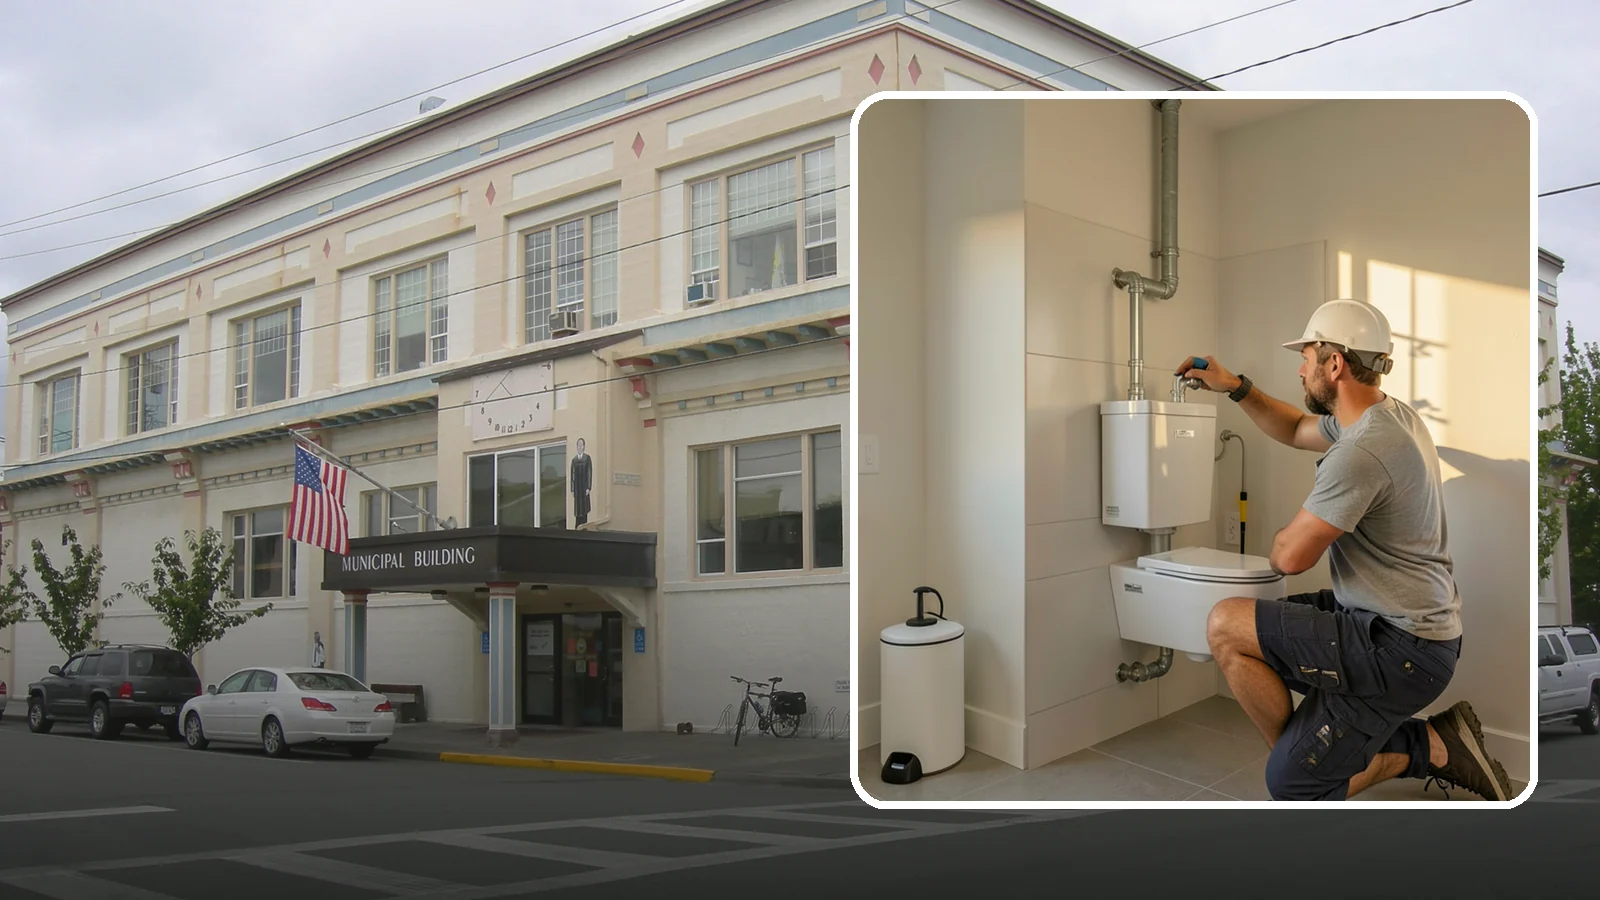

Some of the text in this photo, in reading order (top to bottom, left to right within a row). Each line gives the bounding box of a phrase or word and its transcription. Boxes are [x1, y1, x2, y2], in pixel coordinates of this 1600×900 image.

[480, 406, 485, 415] 8
[487, 417, 493, 426] 9
[494, 423, 501, 432] 10
[507, 425, 514, 433] 12
[520, 419, 526, 428] 2
[528, 413, 533, 422] 3
[535, 402, 540, 410] 4
[342, 546, 475, 572] MUNICIPAL BUILDING
